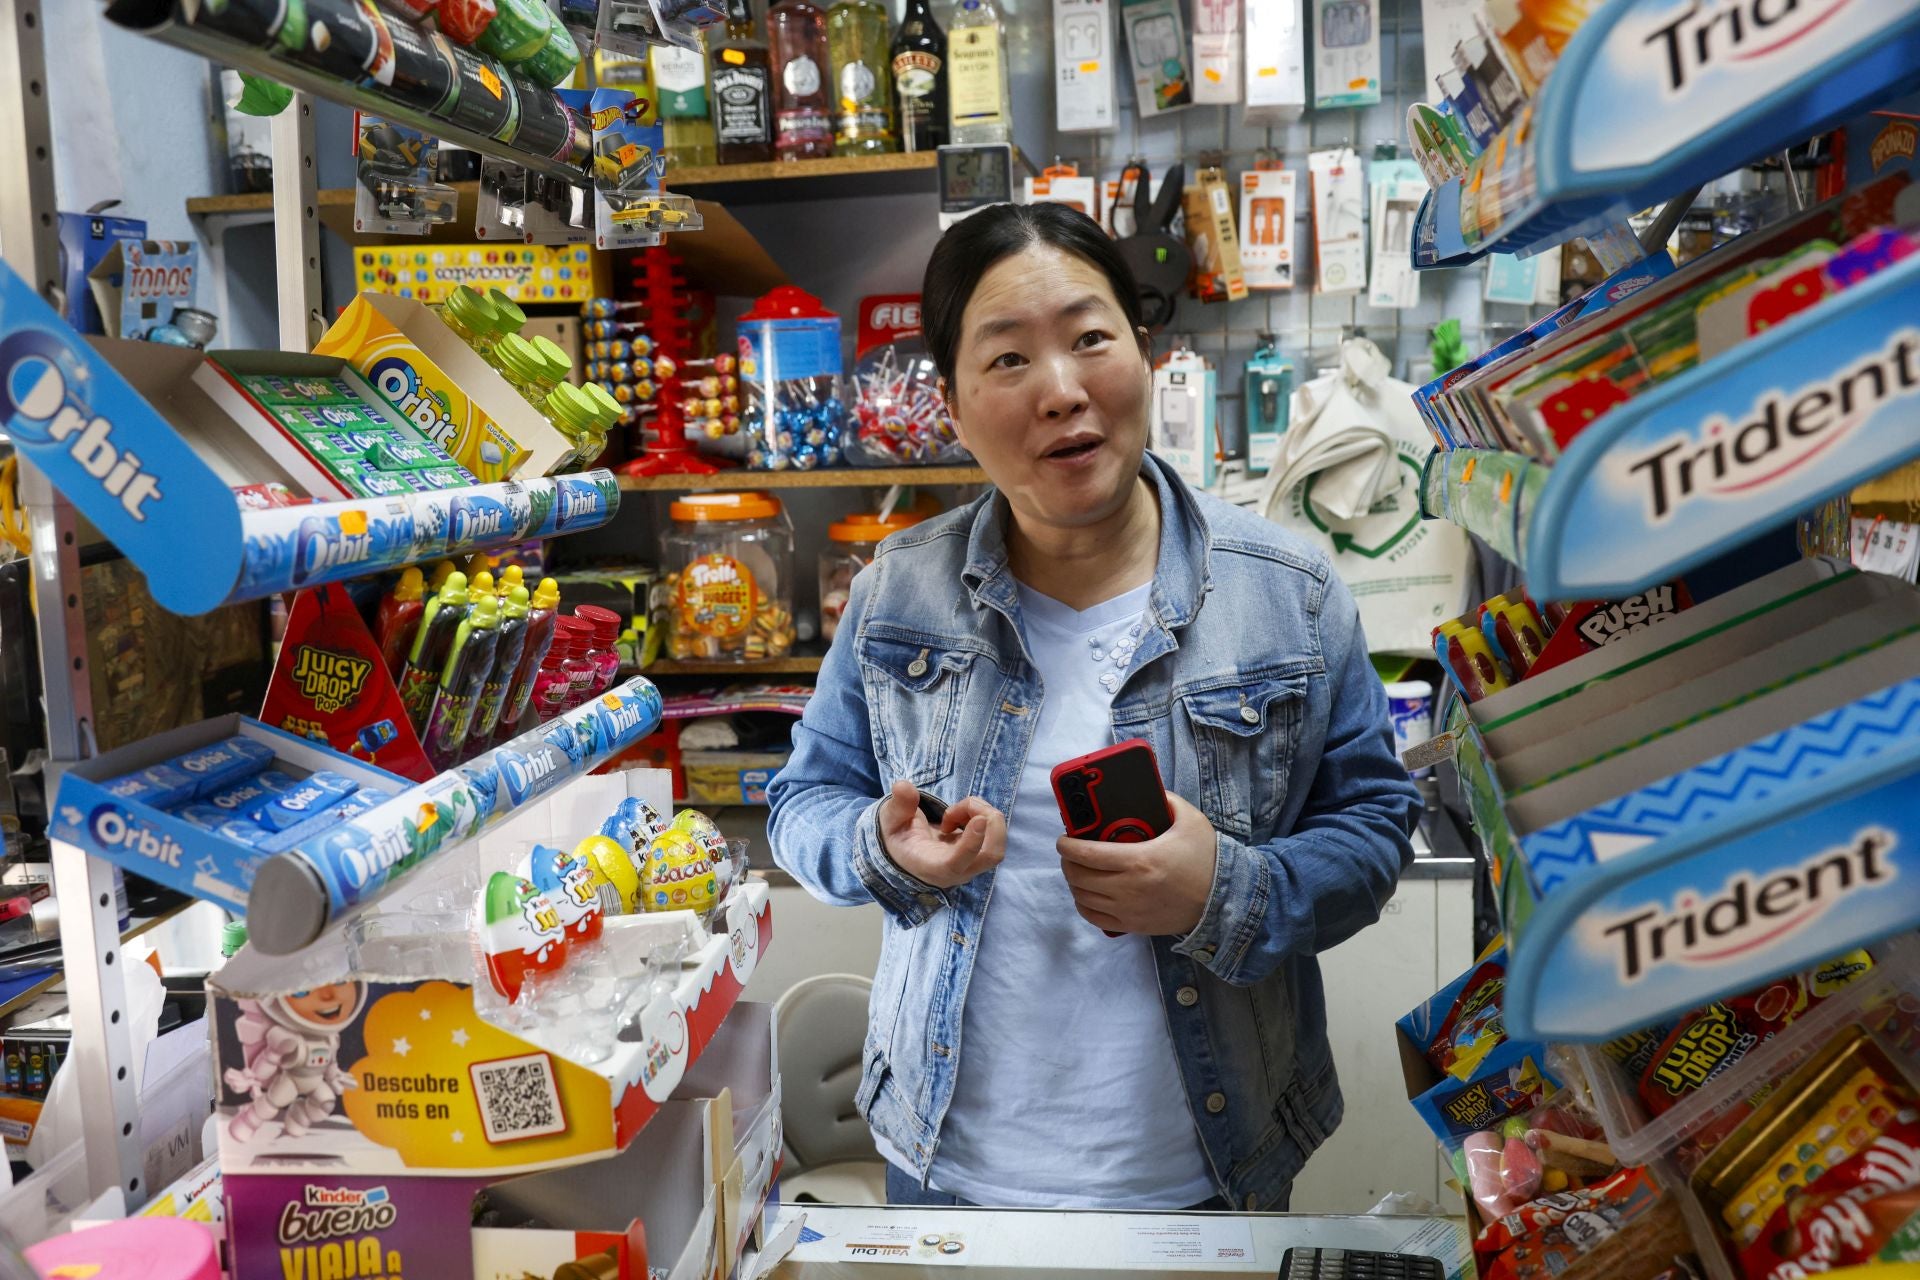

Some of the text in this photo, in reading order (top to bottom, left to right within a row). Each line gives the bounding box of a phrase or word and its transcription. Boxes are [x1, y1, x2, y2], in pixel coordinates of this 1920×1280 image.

[130, 267, 192, 297] TODOS
[294, 381, 331, 398] Orbit
[324, 408, 360, 424] Orbit
[377, 367, 458, 450] Orbit
[8, 354, 164, 522] Orbit
[485, 423, 518, 455] SUGARFREE
[1628, 336, 1920, 520] Trident
[391, 443, 426, 460] Orbit
[366, 477, 403, 493] Orbit
[426, 469, 459, 485] Orbit
[562, 490, 599, 520] Orbit
[454, 505, 503, 543] Orbit
[303, 530, 373, 576] Orbit
[1388, 526, 1428, 563] RECICLA
[1580, 585, 1675, 647] PUSH
[296, 649, 372, 690] JUICY
[306, 674, 351, 701] DROP
[316, 697, 339, 712] POP
[606, 702, 642, 740] Orbit
[182, 750, 233, 773] Orbit
[508, 747, 557, 793] Orbit
[213, 785, 263, 809] Orbit
[280, 786, 324, 811] Orbit
[96, 809, 184, 869] Orbit
[340, 823, 413, 890] Orbit
[1604, 833, 1887, 978] Trident
[1817, 961, 1866, 983] Strawberry
[1654, 1003, 1729, 1091] JUICY
[1681, 1020, 1736, 1085] DROP
[363, 1072, 460, 1093] Descubre
[377, 1099, 449, 1119] más en
[1450, 1083, 1490, 1121] JUICY
[1462, 1098, 1489, 1123] DROP
[308, 1186, 362, 1204] Kinder
[281, 1203, 396, 1242] bueno
[280, 1236, 402, 1280] VIAJA A
